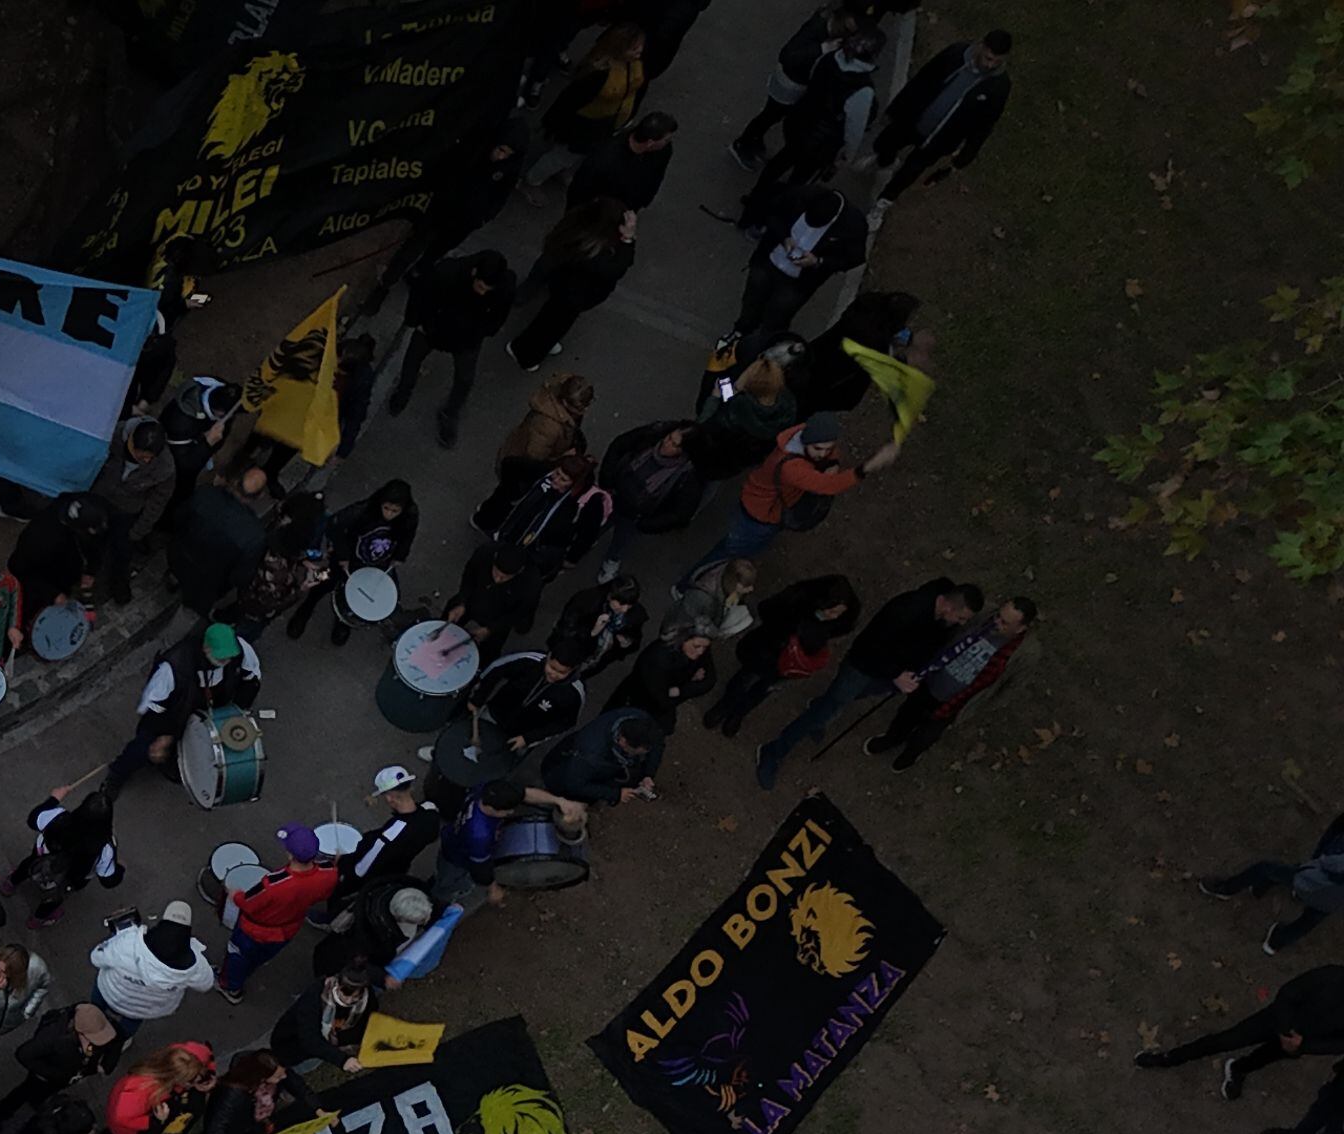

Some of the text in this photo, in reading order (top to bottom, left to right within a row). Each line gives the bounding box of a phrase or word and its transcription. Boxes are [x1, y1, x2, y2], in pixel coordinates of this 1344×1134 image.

[150, 163, 281, 245] MILEI
[330, 156, 425, 187] Tapiales
[318, 210, 372, 238] Aldo
[624, 817, 834, 1064] ALDO BONZI
[775, 958, 908, 1103] MATANZA
